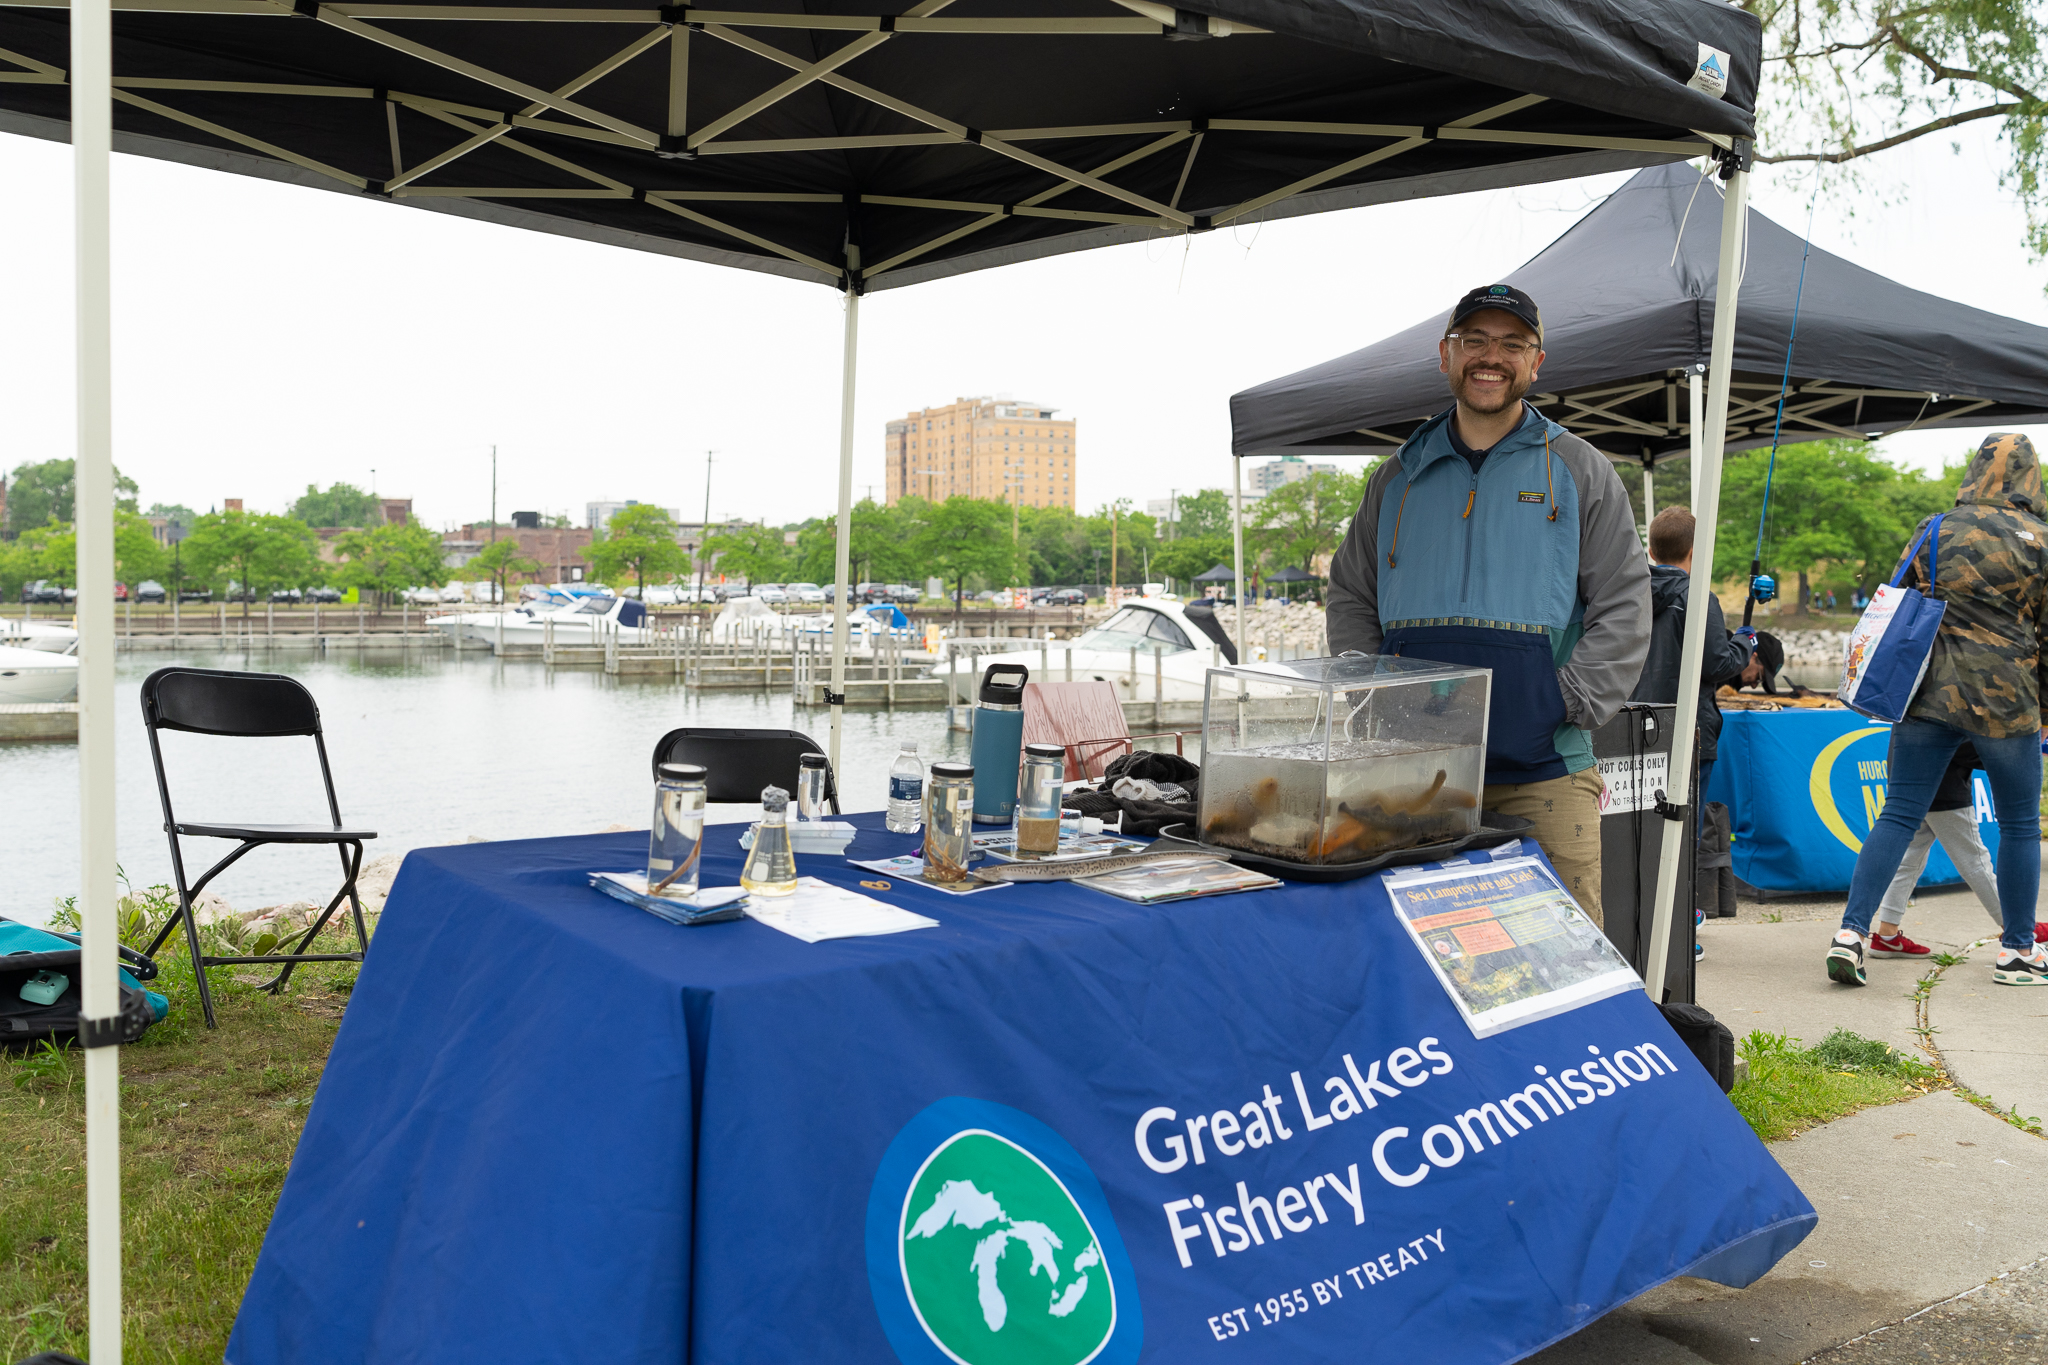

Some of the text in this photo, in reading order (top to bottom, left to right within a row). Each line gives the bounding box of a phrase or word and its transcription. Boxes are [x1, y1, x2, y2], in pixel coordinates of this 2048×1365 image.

[1598, 757, 1666, 774] HOT COALS ONLY
[1614, 777, 1662, 791] CAUTION
[1612, 797, 1621, 806] NO
[1406, 869, 1538, 903] Sea Lampreys are not Eels!
[1134, 1036, 1454, 1174] Great Lakes
[1163, 1042, 1679, 1269] Fishery Commission
[1207, 1228, 1446, 1341] EST 1955 BY TREATY
